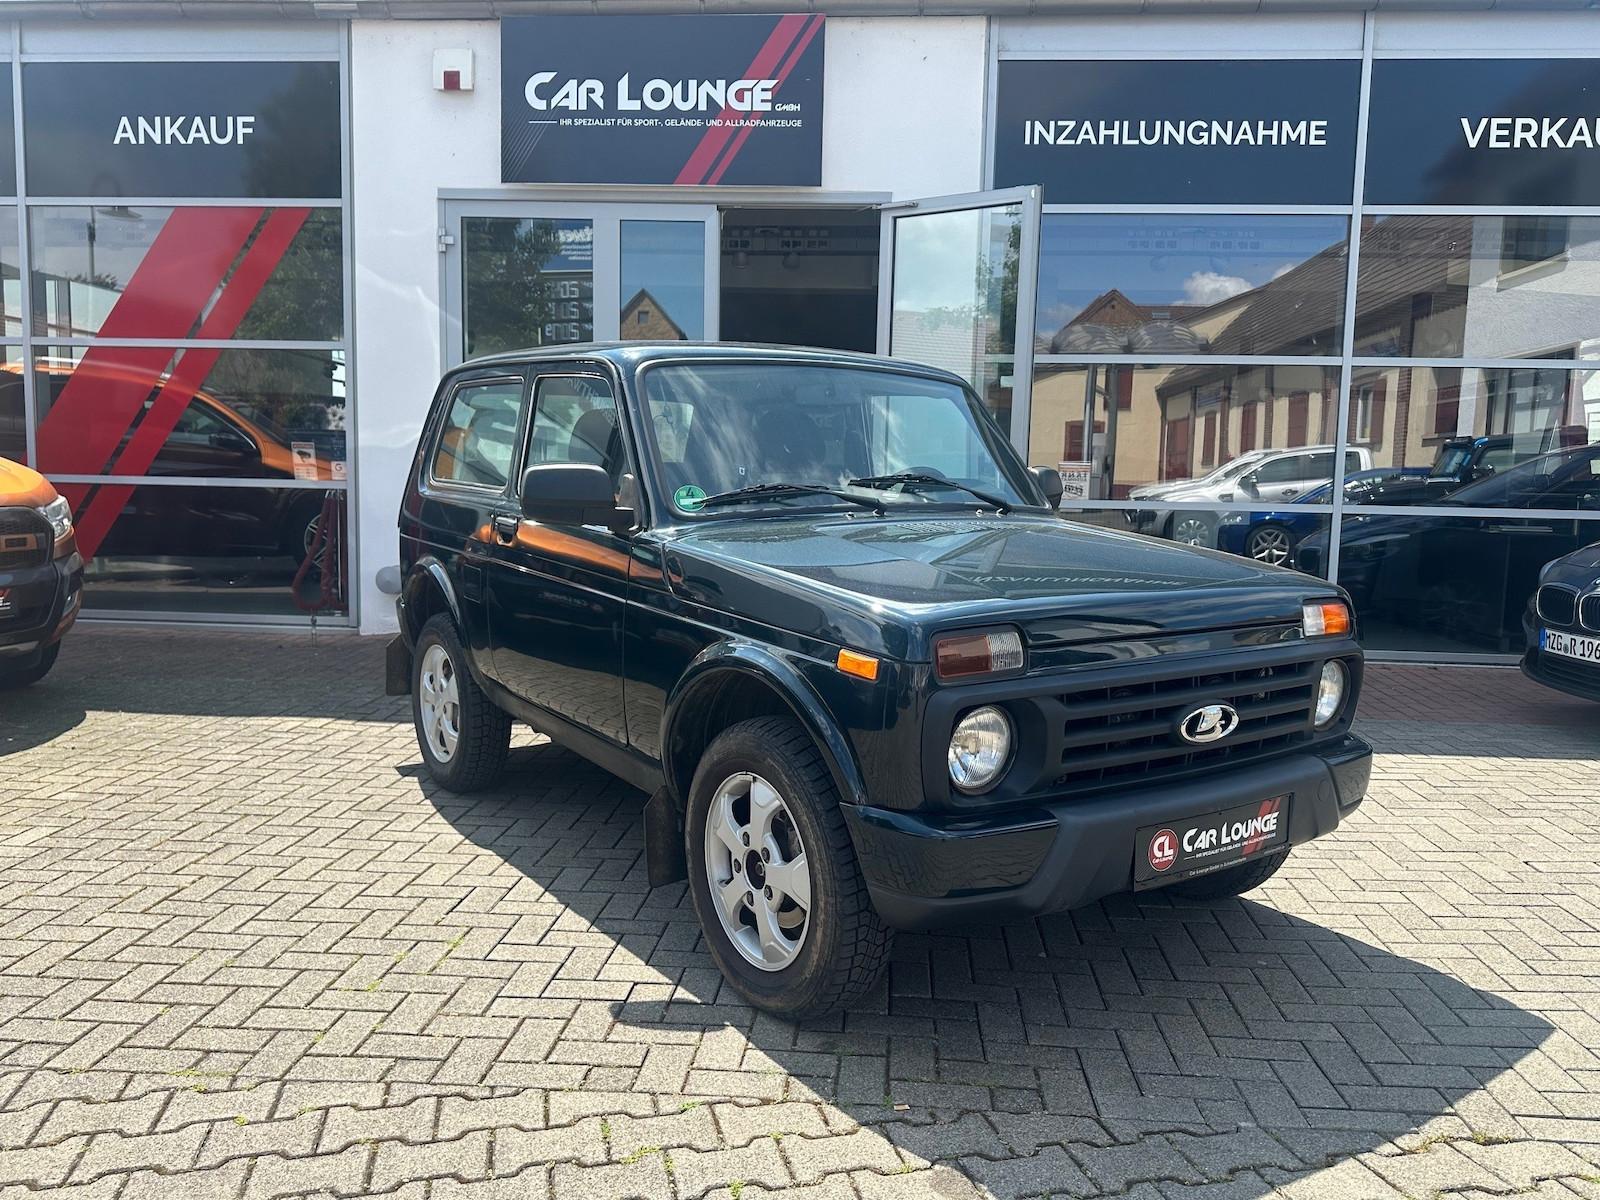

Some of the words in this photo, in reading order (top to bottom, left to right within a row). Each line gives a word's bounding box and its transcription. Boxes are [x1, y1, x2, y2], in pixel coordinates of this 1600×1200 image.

[525, 72, 604, 110] CAR
[618, 72, 779, 111] LOUNGE
[113, 116, 255, 145] ANKAUF
[560, 118, 572, 126] IHR
[574, 118, 616, 126] SPEZIALIST
[617, 117, 633, 126] FÜR
[634, 118, 663, 127] SPORT-,
[665, 117, 704, 127] GELÄNDE-
[706, 119, 723, 127] UND
[725, 119, 802, 127] ALLRADFAHRZEUGE
[1024, 120, 1327, 145] INZAHLUNGNAHME
[1460, 117, 1600, 148] VERKA
[686, 487, 695, 498] 4
[1570, 638, 1576, 656] R
[1183, 828, 1217, 852] CAR
[1221, 811, 1280, 844] LOUNGE
[1153, 835, 1174, 858] CL
